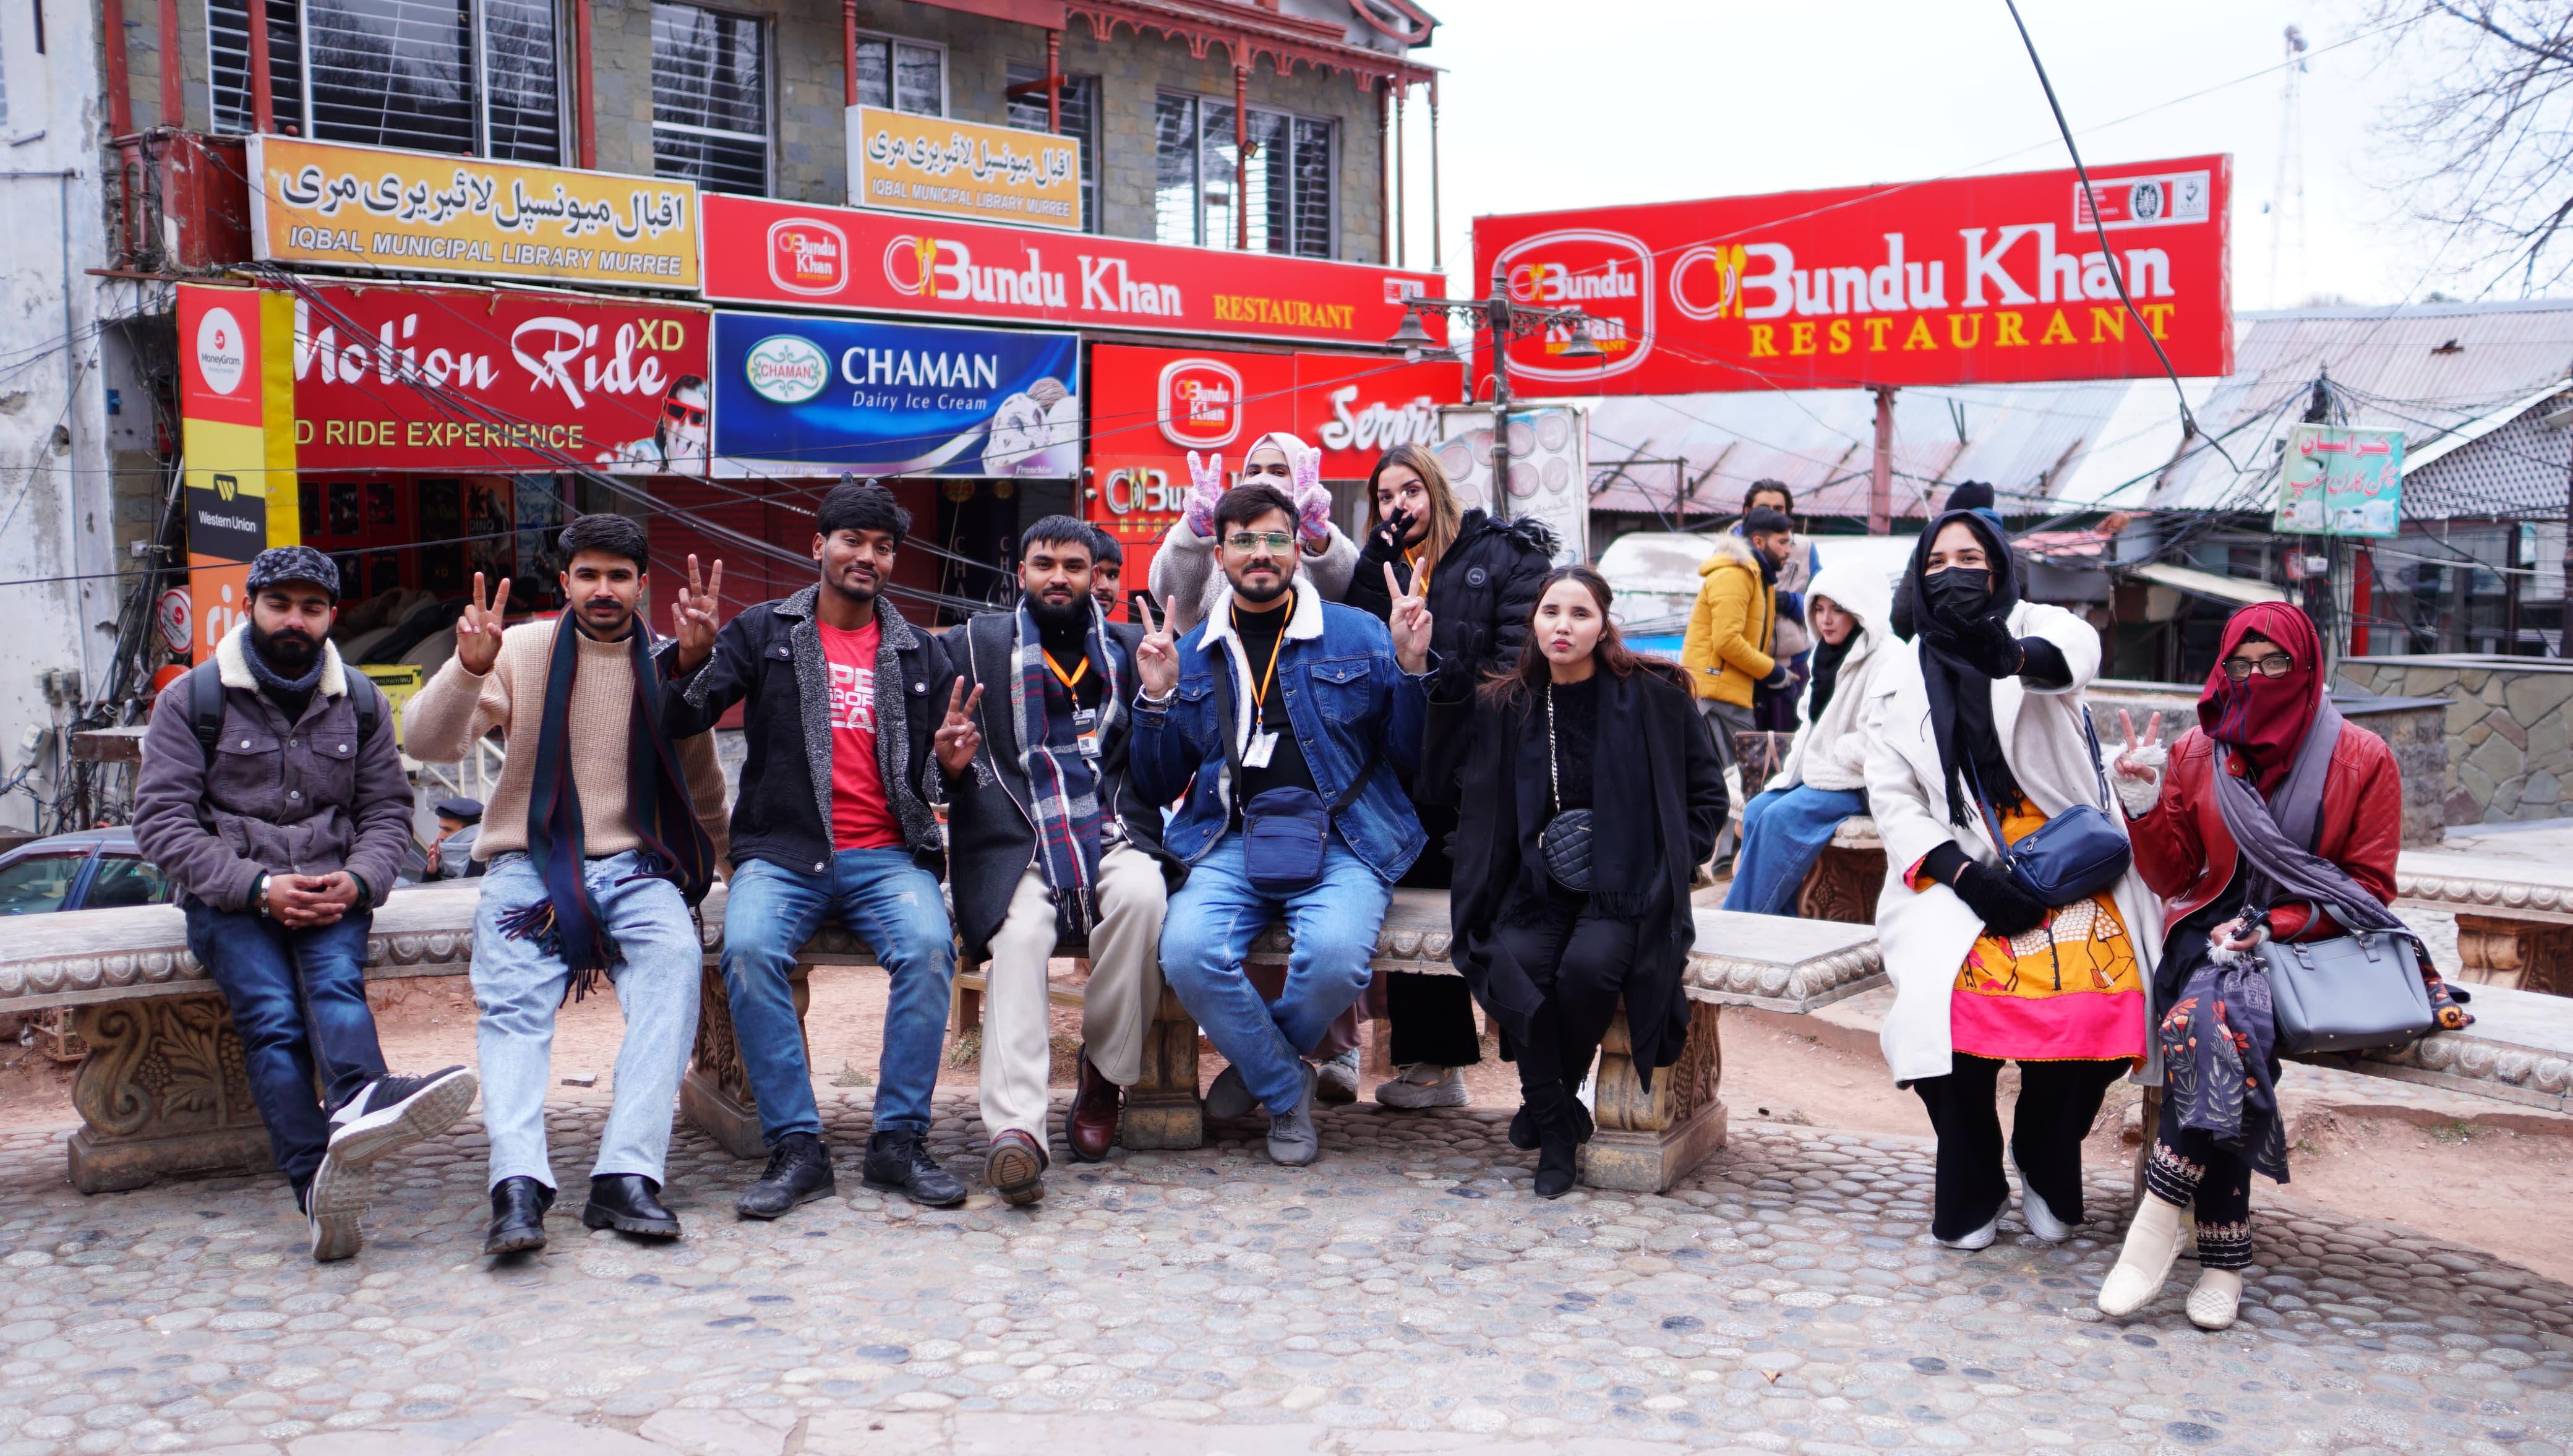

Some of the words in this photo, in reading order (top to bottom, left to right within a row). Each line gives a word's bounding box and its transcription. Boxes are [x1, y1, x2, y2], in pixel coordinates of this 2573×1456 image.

[283, 168, 357, 212] مری
[495, 181, 610, 233] میونسپل
[872, 178, 908, 198] IQBAL
[912, 183, 972, 206] MUNICIPAL
[975, 191, 1023, 212] LIBRARY
[1025, 198, 1071, 217] MURREE
[615, 194, 682, 238] اقبال
[290, 226, 364, 252] IQBAL
[372, 232, 495, 262] MUNICIPAL
[502, 242, 594, 269] LIBRARY
[598, 250, 682, 276] MURREE
[794, 233, 836, 257] Bundu
[795, 254, 833, 275] Khan
[1543, 259, 1637, 302] Bundu
[1741, 232, 1948, 320] Bundu
[1959, 223, 2175, 307] Khan
[933, 239, 1068, 307] Bundu
[1077, 255, 1183, 316] Khan
[1212, 294, 1355, 330] RESTAURANT
[1545, 305, 1626, 343] Kan
[1747, 302, 2175, 359] RESTAURANT
[201, 353, 240, 366] MoneyGram
[512, 315, 667, 409] Ride
[635, 317, 684, 351] XD
[761, 364, 811, 380] CHAMAN
[841, 346, 997, 390] CHAMAN
[852, 390, 899, 413] Dairy
[905, 392, 930, 409] Ice
[938, 393, 987, 411] Cream
[1190, 380, 1229, 403] Bundu
[1190, 400, 1225, 422] Khan
[325, 419, 396, 446] RIDE
[407, 421, 584, 449] EXPERIENCE
[199, 510, 232, 529] Western
[232, 515, 256, 533] Union
[469, 520, 495, 532] DINO
